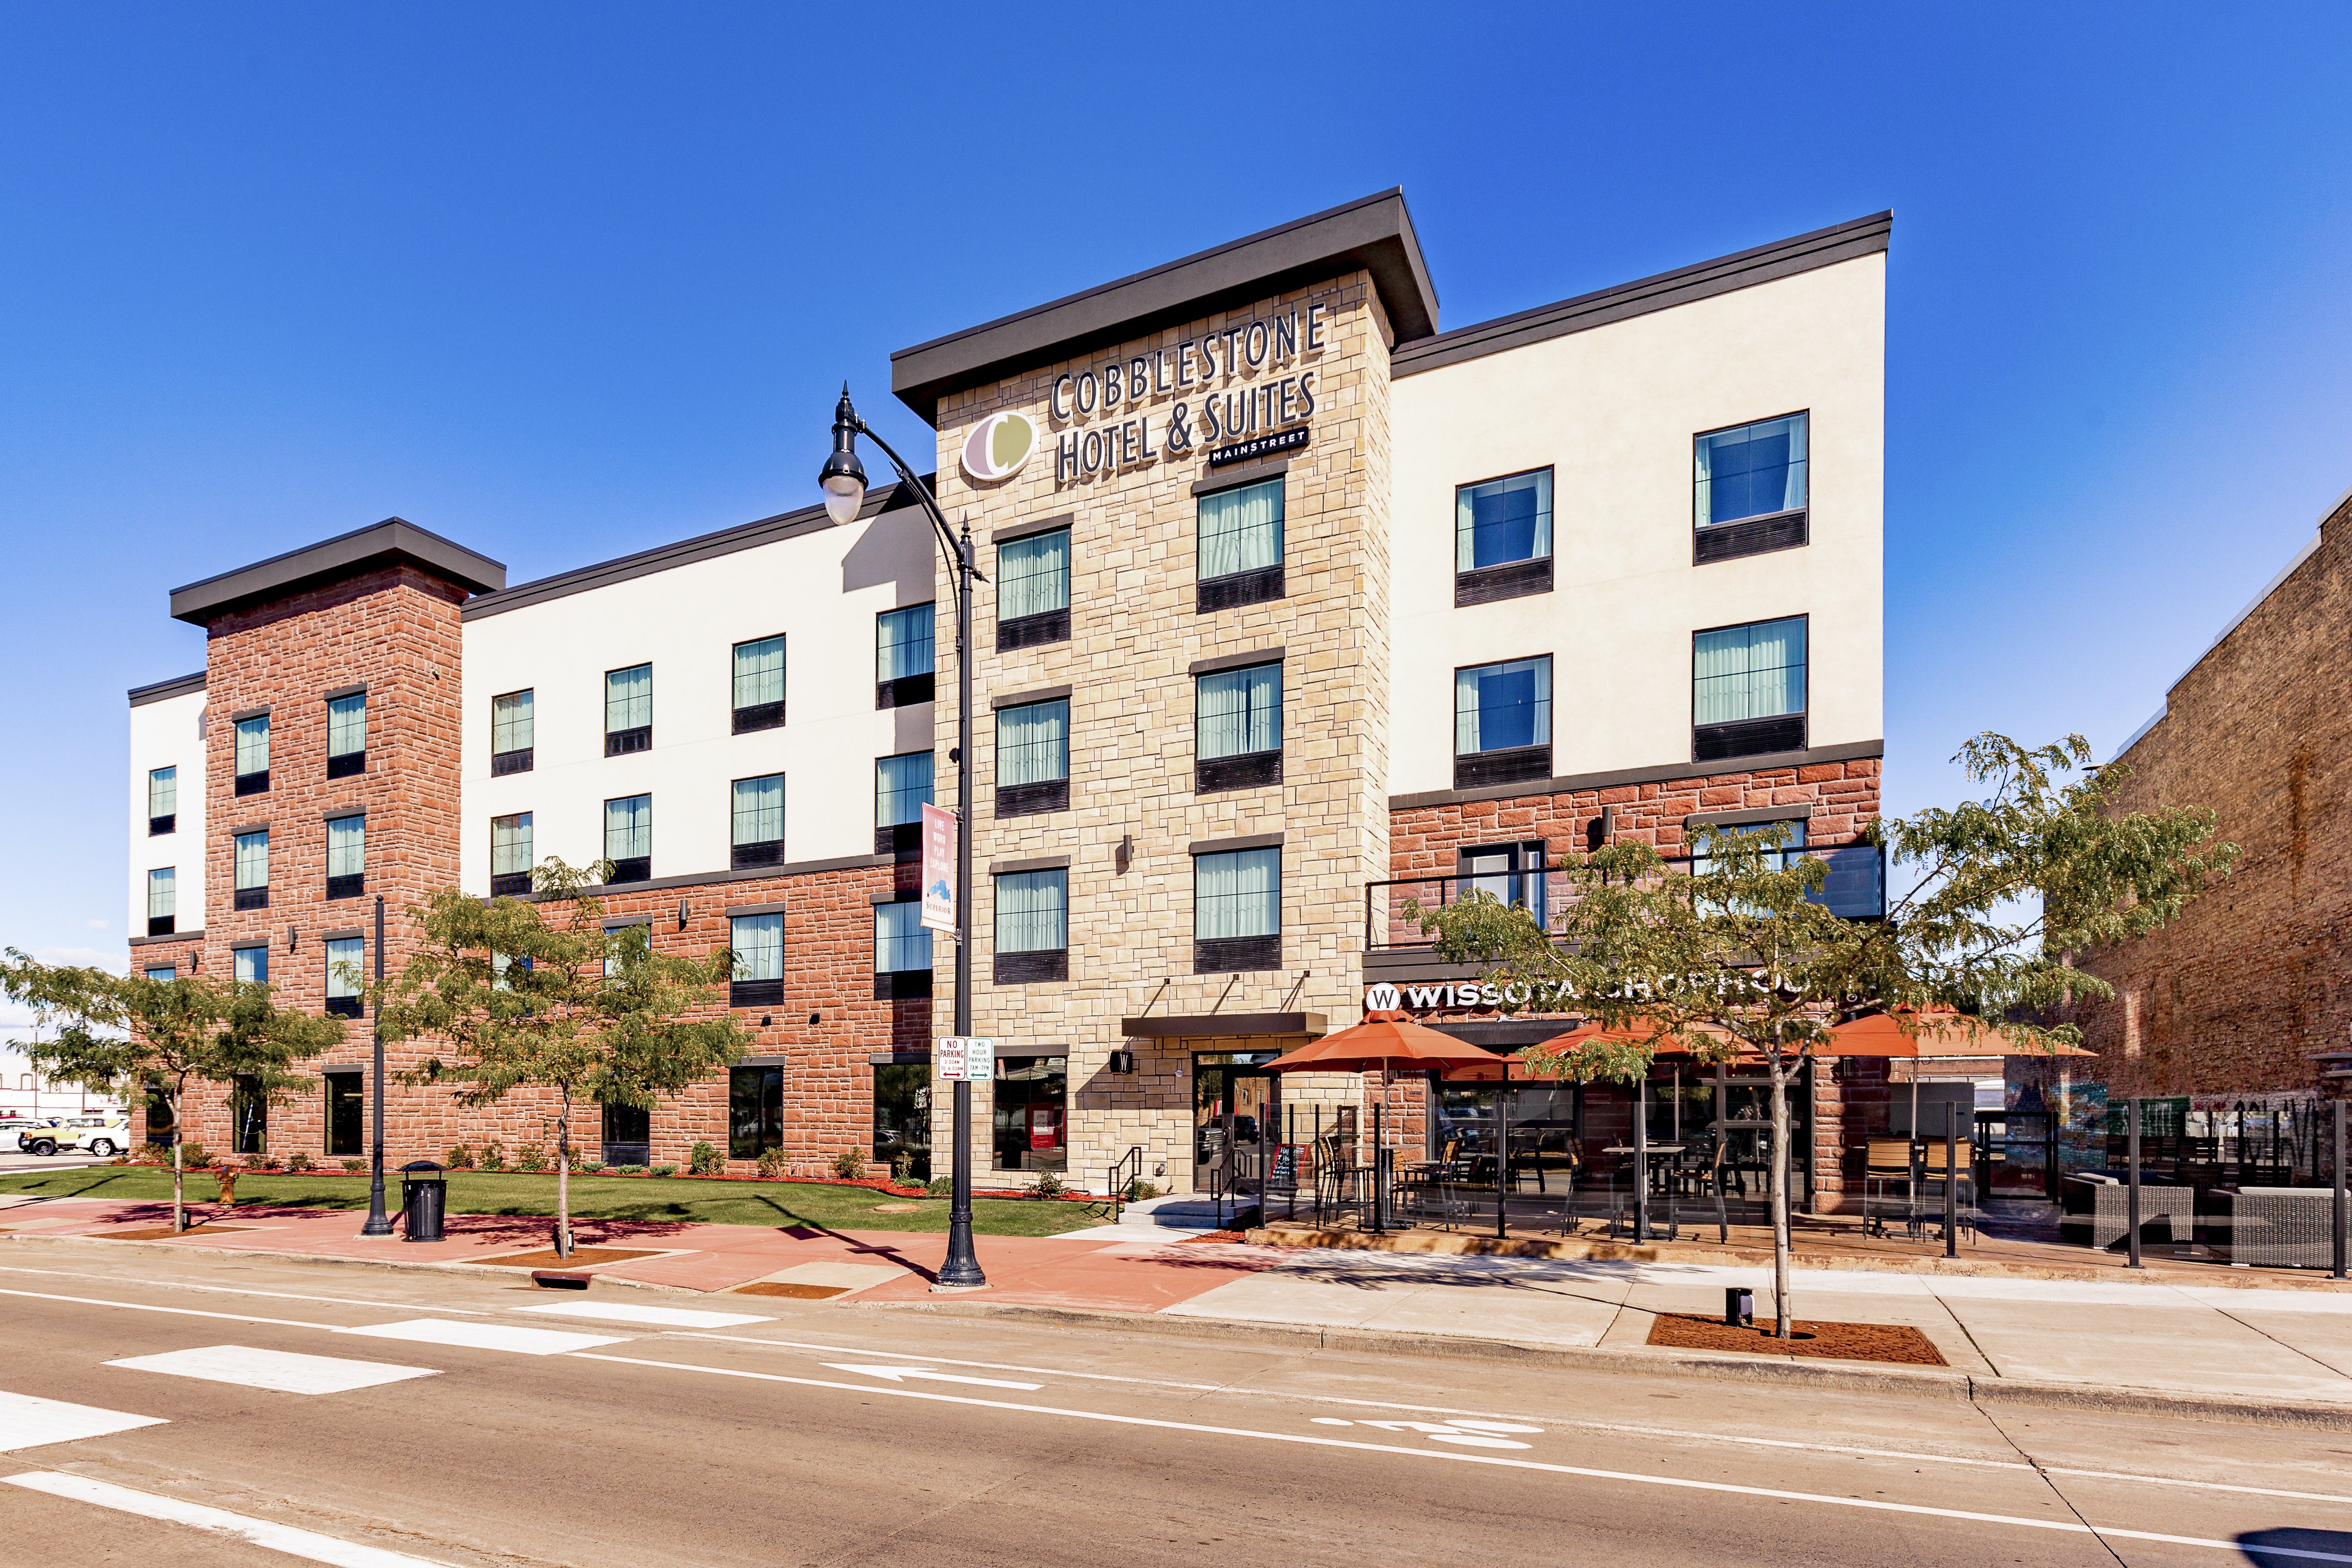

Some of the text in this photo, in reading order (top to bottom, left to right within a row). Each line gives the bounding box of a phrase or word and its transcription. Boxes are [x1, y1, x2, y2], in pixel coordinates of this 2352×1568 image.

[1051, 302, 1327, 425] COBBLESTONE
[1057, 371, 1318, 484] HOTEL & SUITES
[1212, 431, 1306, 462] MAINSTREET
[934, 818, 944, 831] LIVE
[933, 831, 946, 845] WORK
[934, 845, 945, 858] PLAY
[930, 859, 949, 873] EXPLORE
[926, 901, 951, 915] SUPERIOR
[1372, 989, 1394, 1009] W
[947, 1040, 957, 1048] NO
[940, 1049, 964, 1058] PARKING
[1120, 1054, 1128, 1071] W
